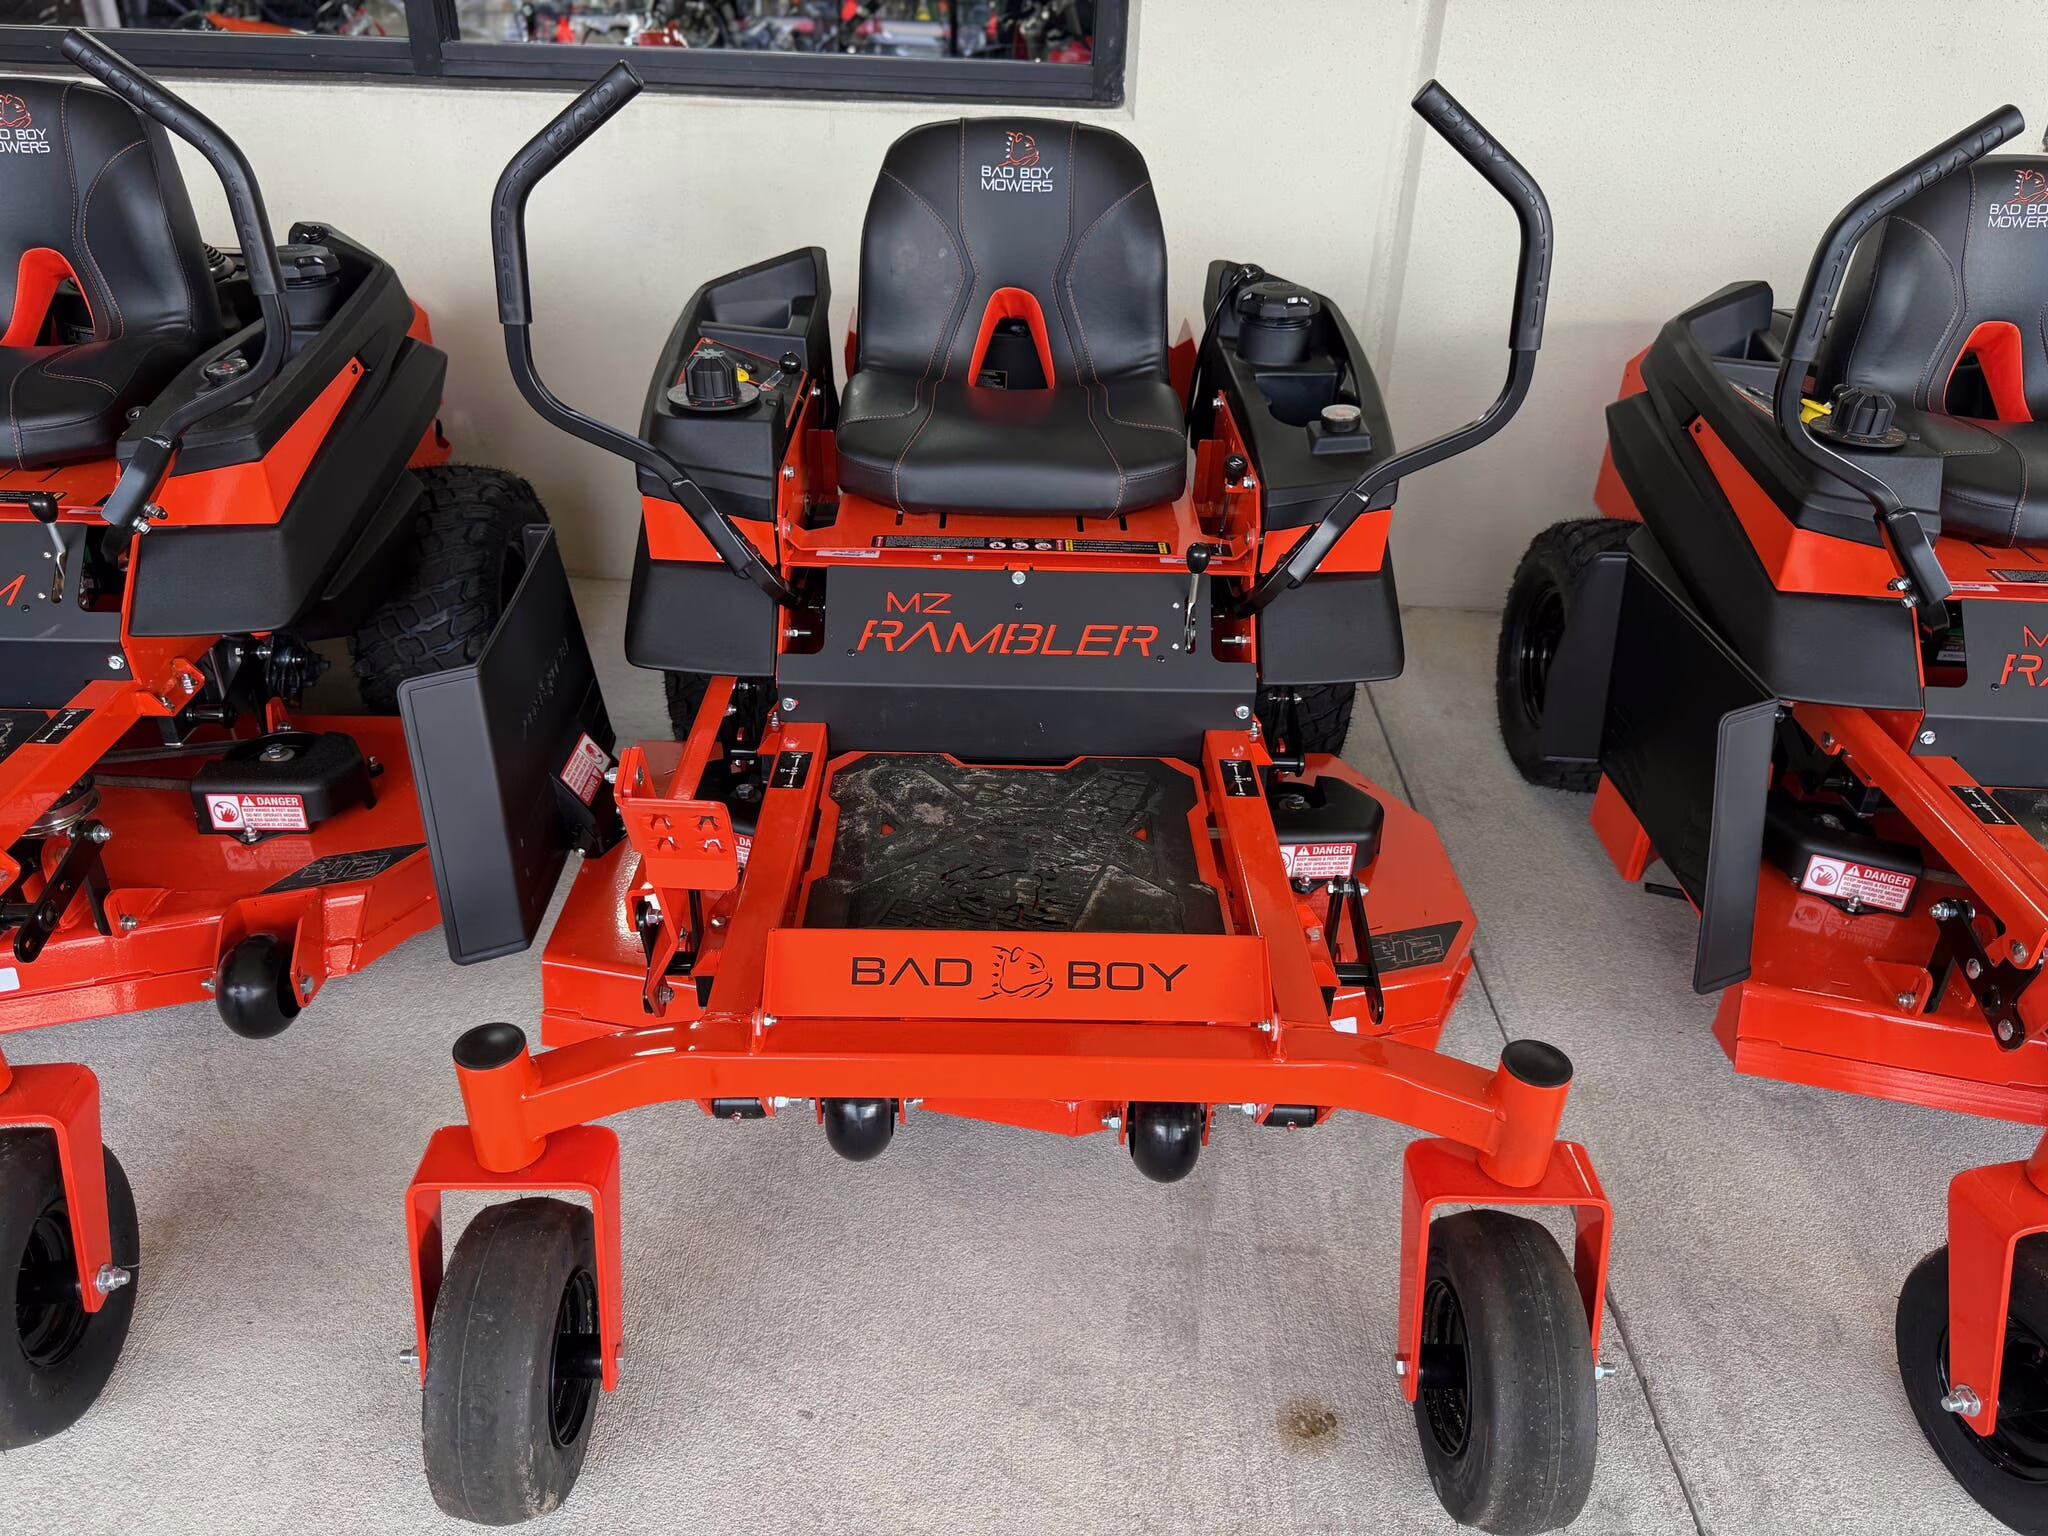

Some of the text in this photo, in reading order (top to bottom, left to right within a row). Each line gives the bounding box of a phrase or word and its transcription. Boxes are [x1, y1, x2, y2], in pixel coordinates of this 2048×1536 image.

[545, 81, 617, 153] BAD
[15, 128, 47, 140] BOY
[1430, 99, 1509, 168] BOY
[1913, 126, 2004, 190] BAD
[981, 165, 1054, 179] BAD BOY
[981, 178, 1054, 192] MOWERS
[1989, 203, 2021, 215] BAD
[886, 592, 952, 614] MZ
[857, 620, 1159, 657] RAMBLER
[256, 797, 299, 806] DANGER
[1312, 845, 1353, 855] DANGER
[1863, 869, 1911, 887] DANGER
[851, 957, 1189, 993] BAD BOY
